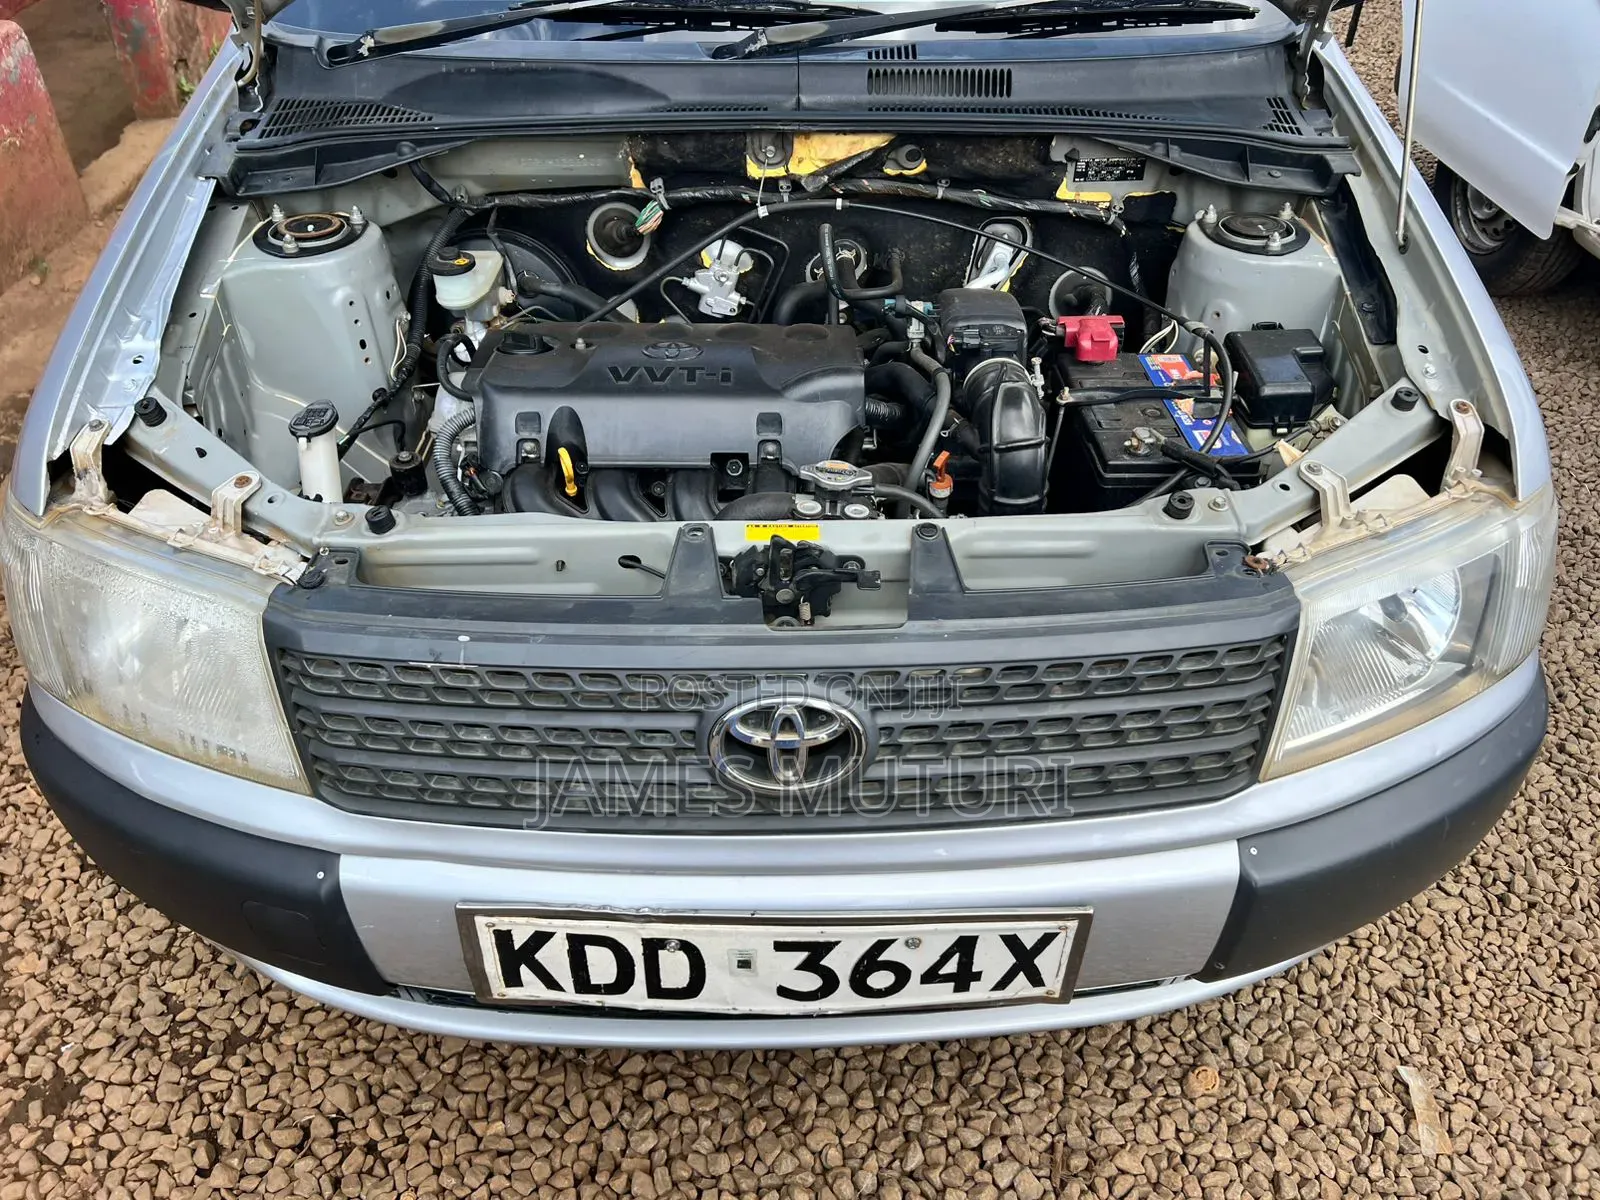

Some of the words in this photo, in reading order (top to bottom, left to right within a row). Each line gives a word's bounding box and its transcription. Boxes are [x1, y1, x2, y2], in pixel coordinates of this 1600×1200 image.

[607, 365, 732, 385] VVT-i
[493, 928, 706, 1000] KDD
[773, 931, 1060, 1002] 364X
